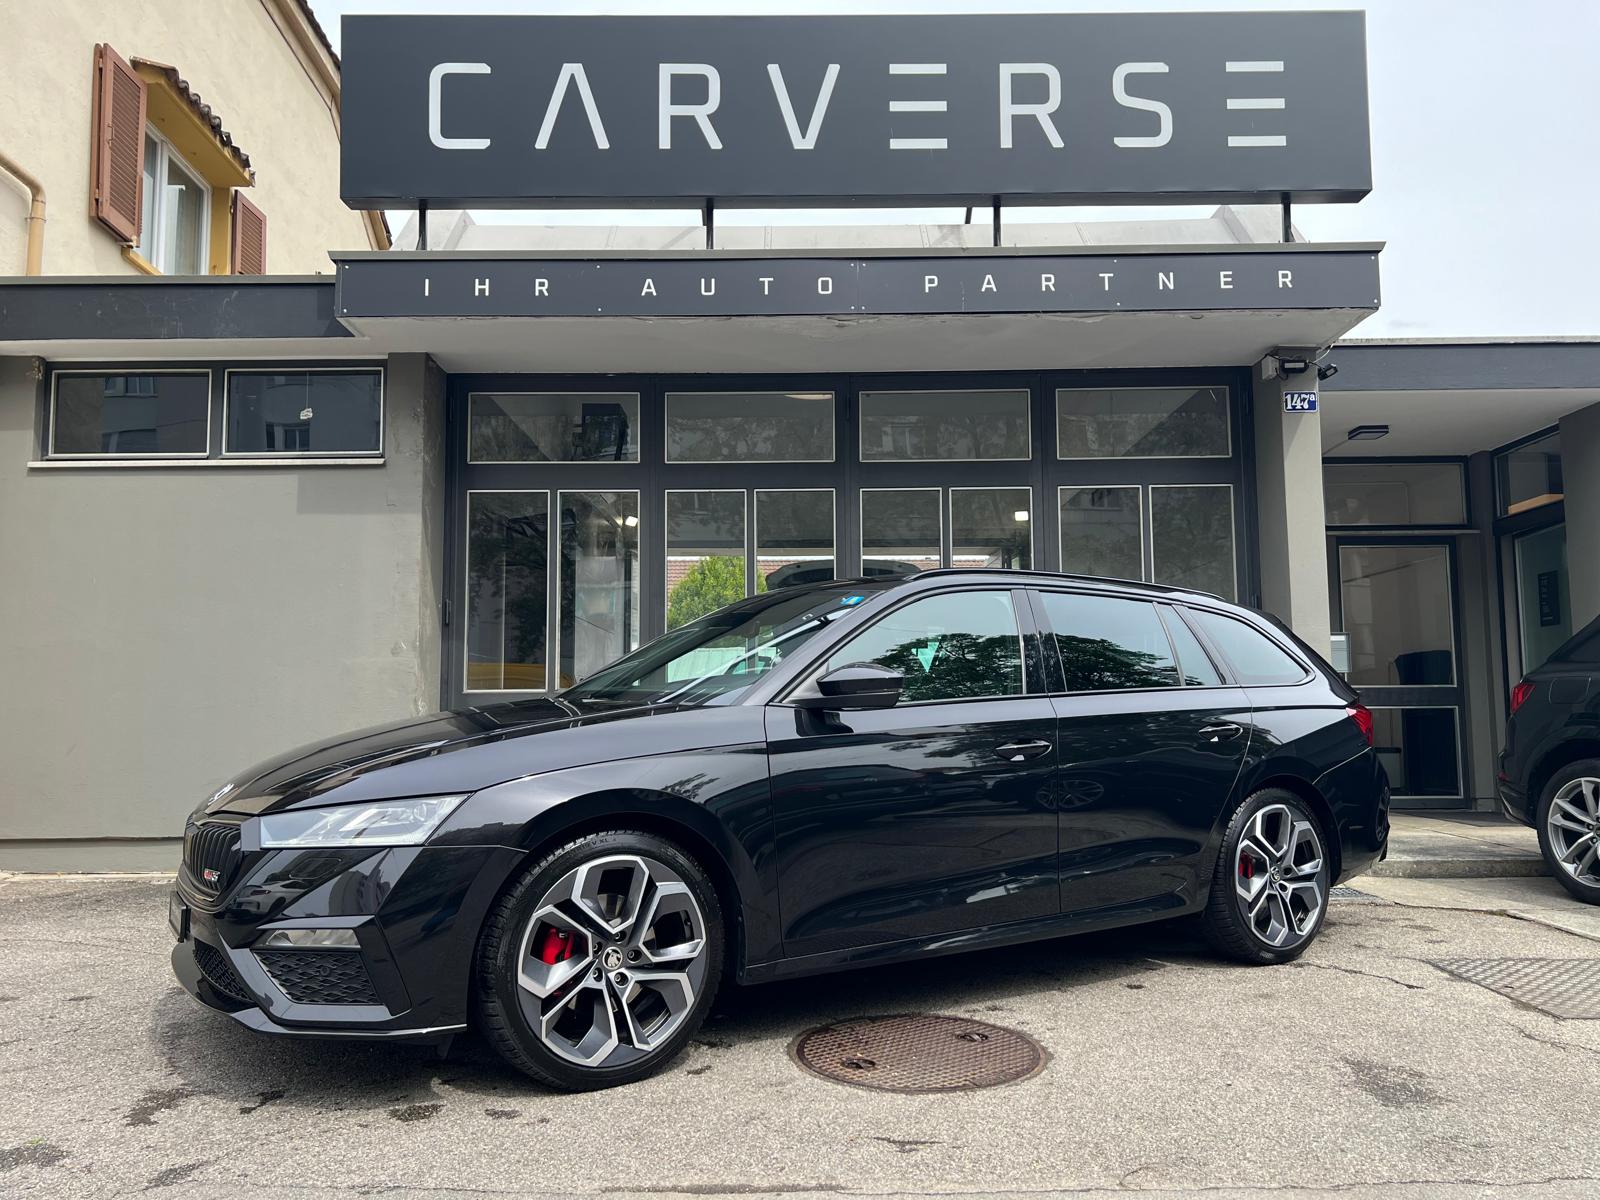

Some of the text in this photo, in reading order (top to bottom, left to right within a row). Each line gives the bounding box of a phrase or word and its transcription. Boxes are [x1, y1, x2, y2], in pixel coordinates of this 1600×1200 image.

[428, 60, 1288, 150] CARVERSE
[424, 269, 1294, 297] IHR AUTO PARTNER
[1285, 394, 1316, 410] 147a
